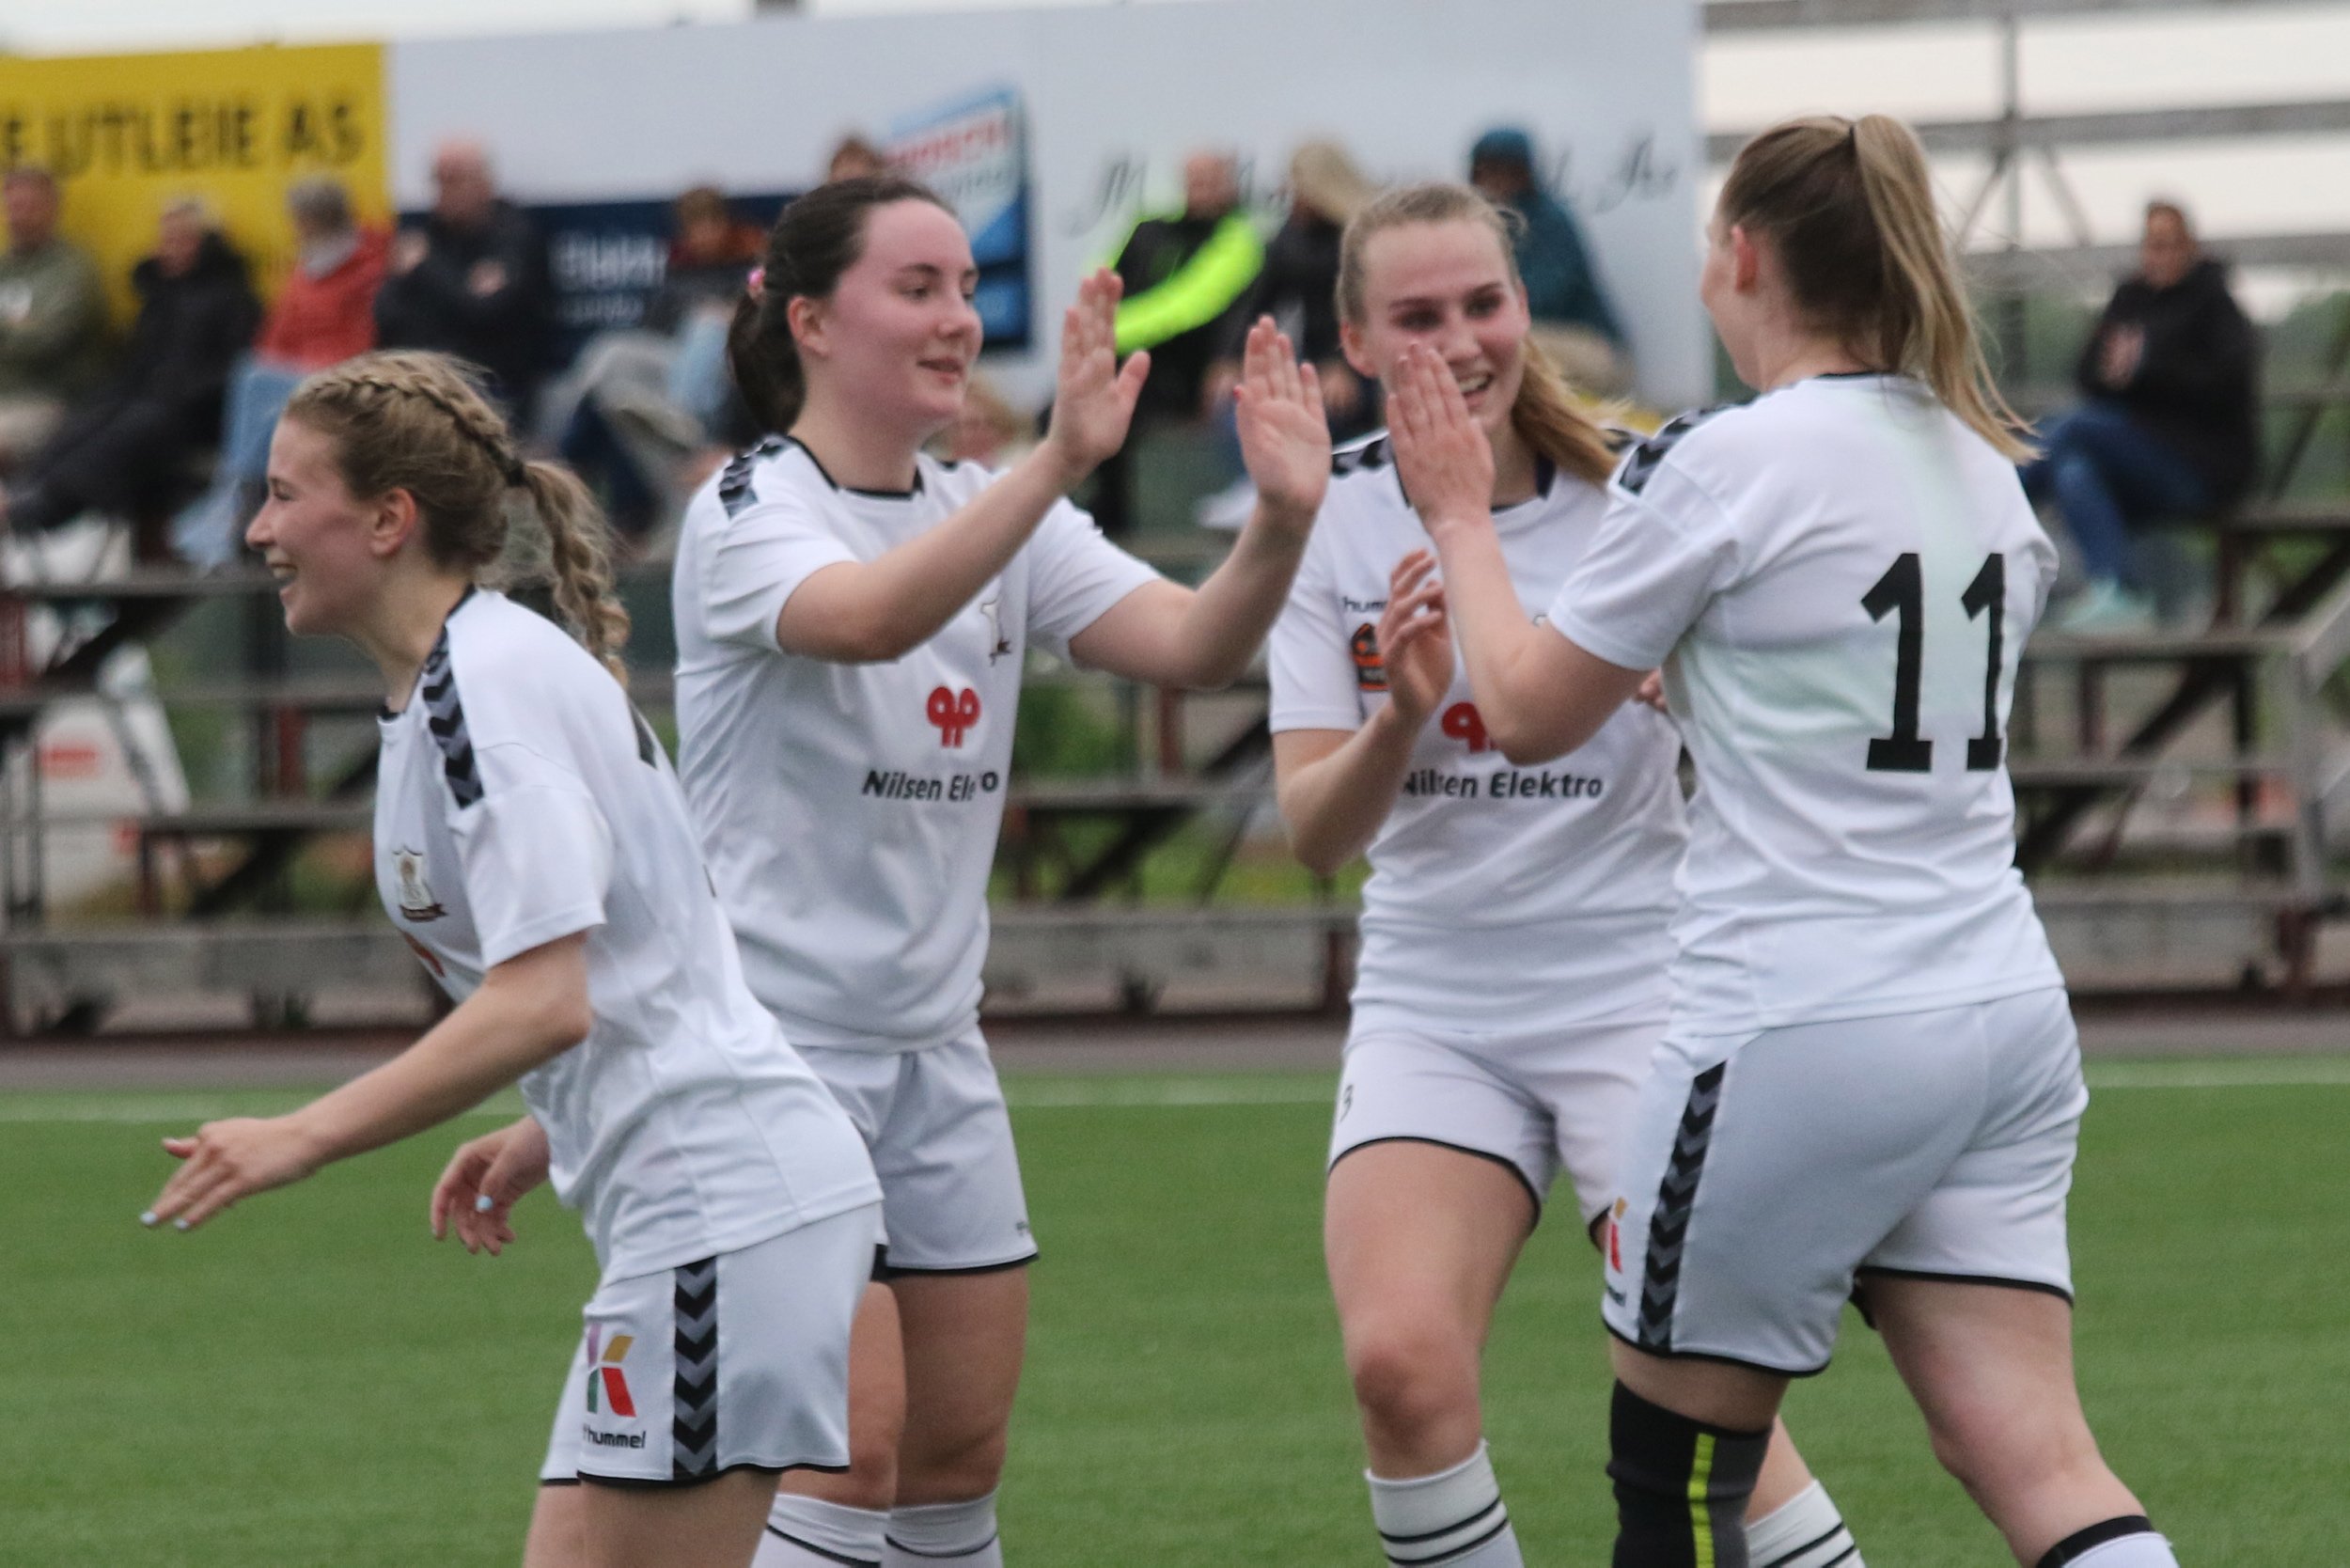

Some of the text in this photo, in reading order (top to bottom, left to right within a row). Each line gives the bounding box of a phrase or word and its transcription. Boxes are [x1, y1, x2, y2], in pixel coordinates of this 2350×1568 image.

[45, 103, 261, 180] UTLEIE
[285, 102, 364, 167] AS
[1860, 552, 2006, 773] 11
[861, 770, 942, 801] Nilsen
[1489, 771, 1604, 798] Elektro
[588, 1428, 647, 1449] hummel
